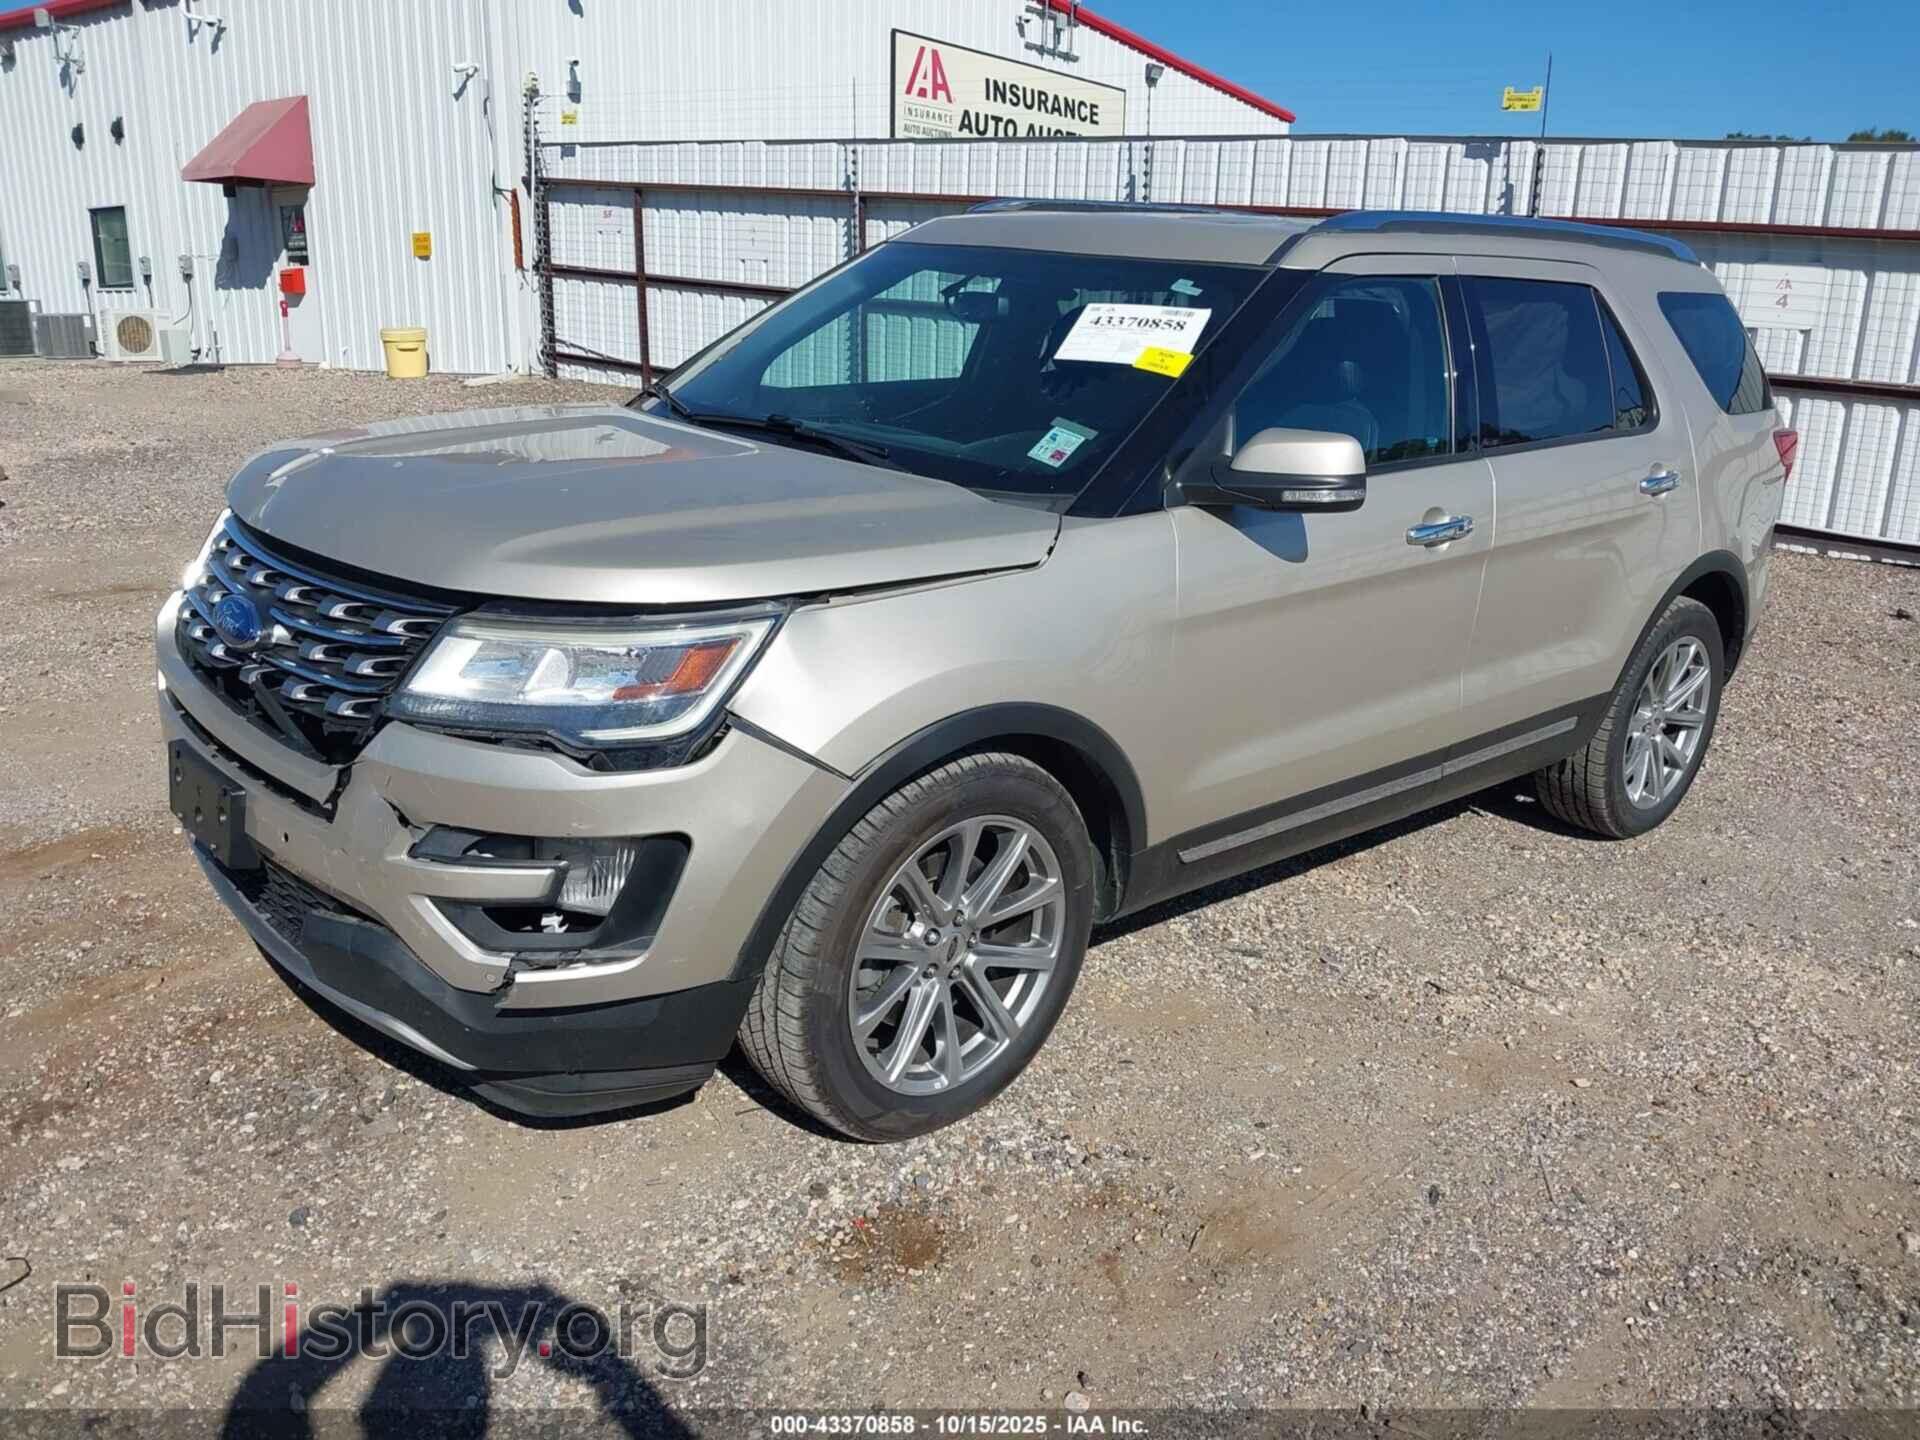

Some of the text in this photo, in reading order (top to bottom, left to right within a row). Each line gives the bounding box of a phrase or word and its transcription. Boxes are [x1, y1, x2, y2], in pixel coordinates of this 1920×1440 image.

[985, 77, 1100, 126] INSURANCE
[903, 105, 952, 124] INSURANCE
[958, 109, 1018, 137] AUTO
[1776, 294, 1788, 308] 4
[1089, 315, 1187, 331] 43370858
